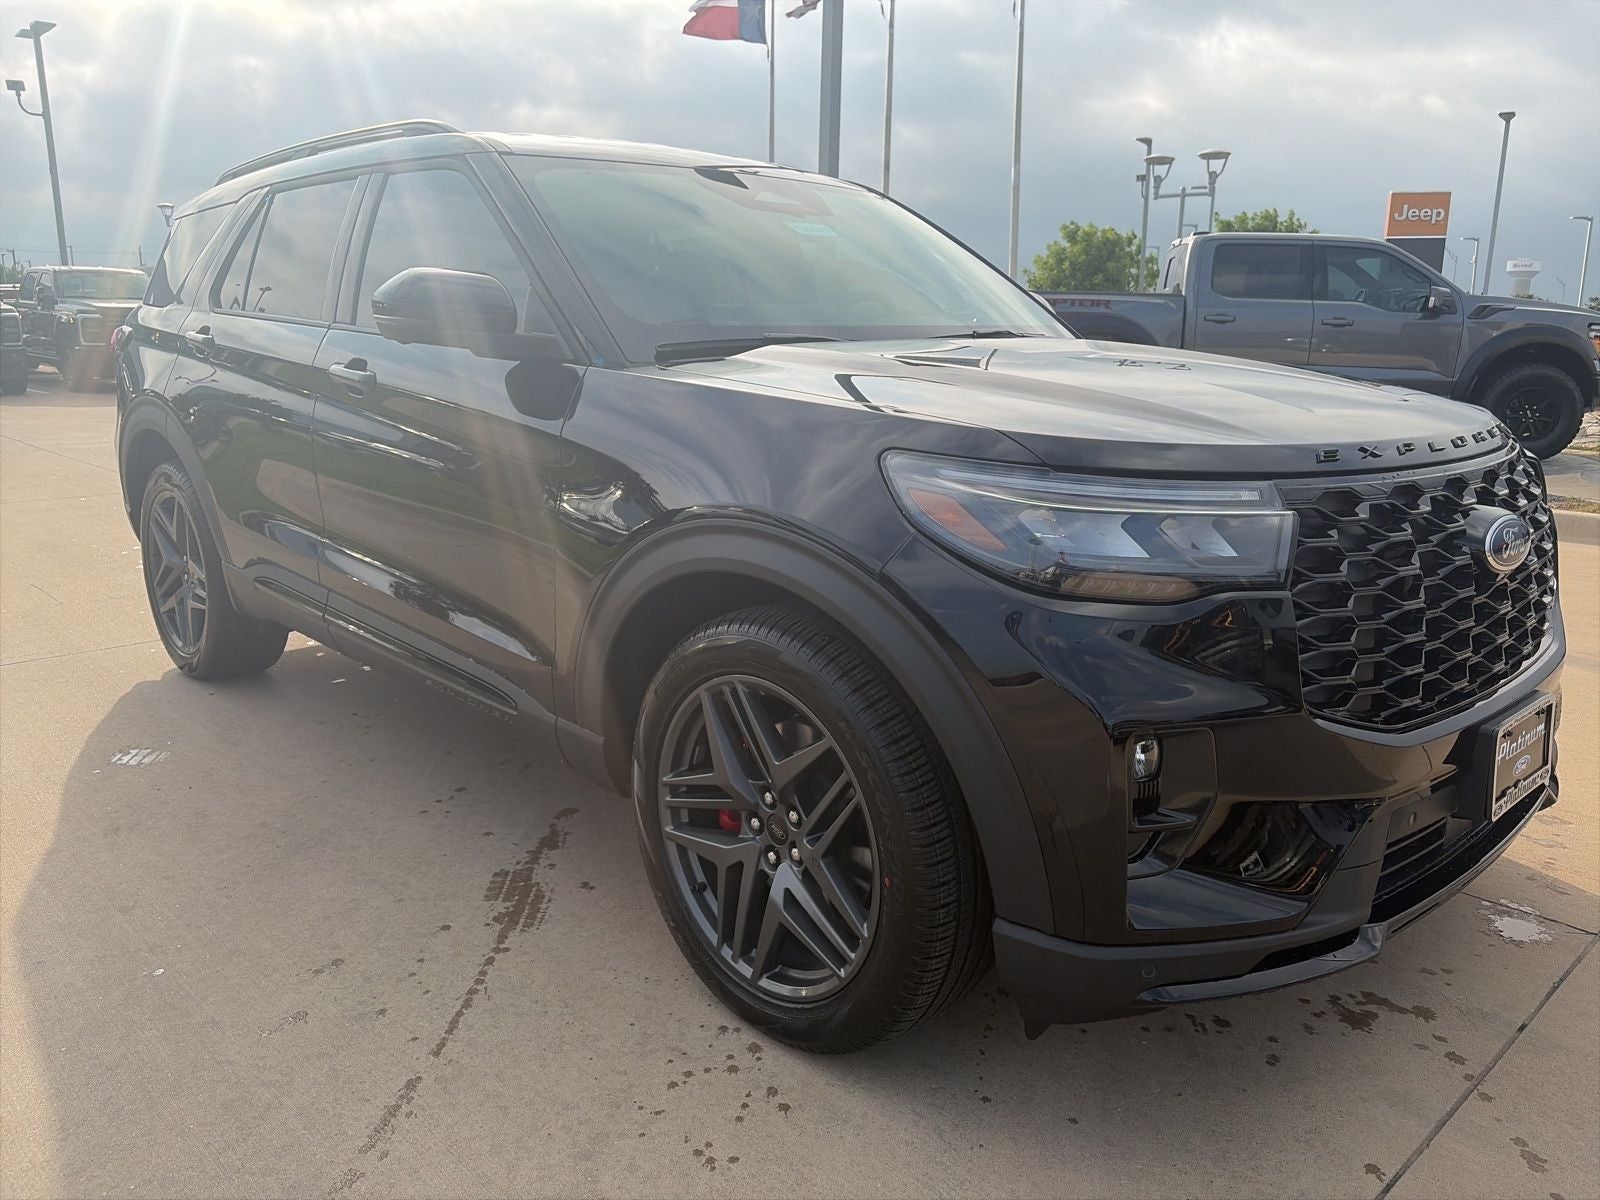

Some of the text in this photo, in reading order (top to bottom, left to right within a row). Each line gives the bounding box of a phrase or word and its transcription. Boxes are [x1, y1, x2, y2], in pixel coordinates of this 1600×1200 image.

[1393, 204, 1445, 223] Jeep
[1050, 298, 1113, 311] PTOR
[1502, 526, 1529, 559] Ford
[1497, 722, 1547, 765] Platinum
